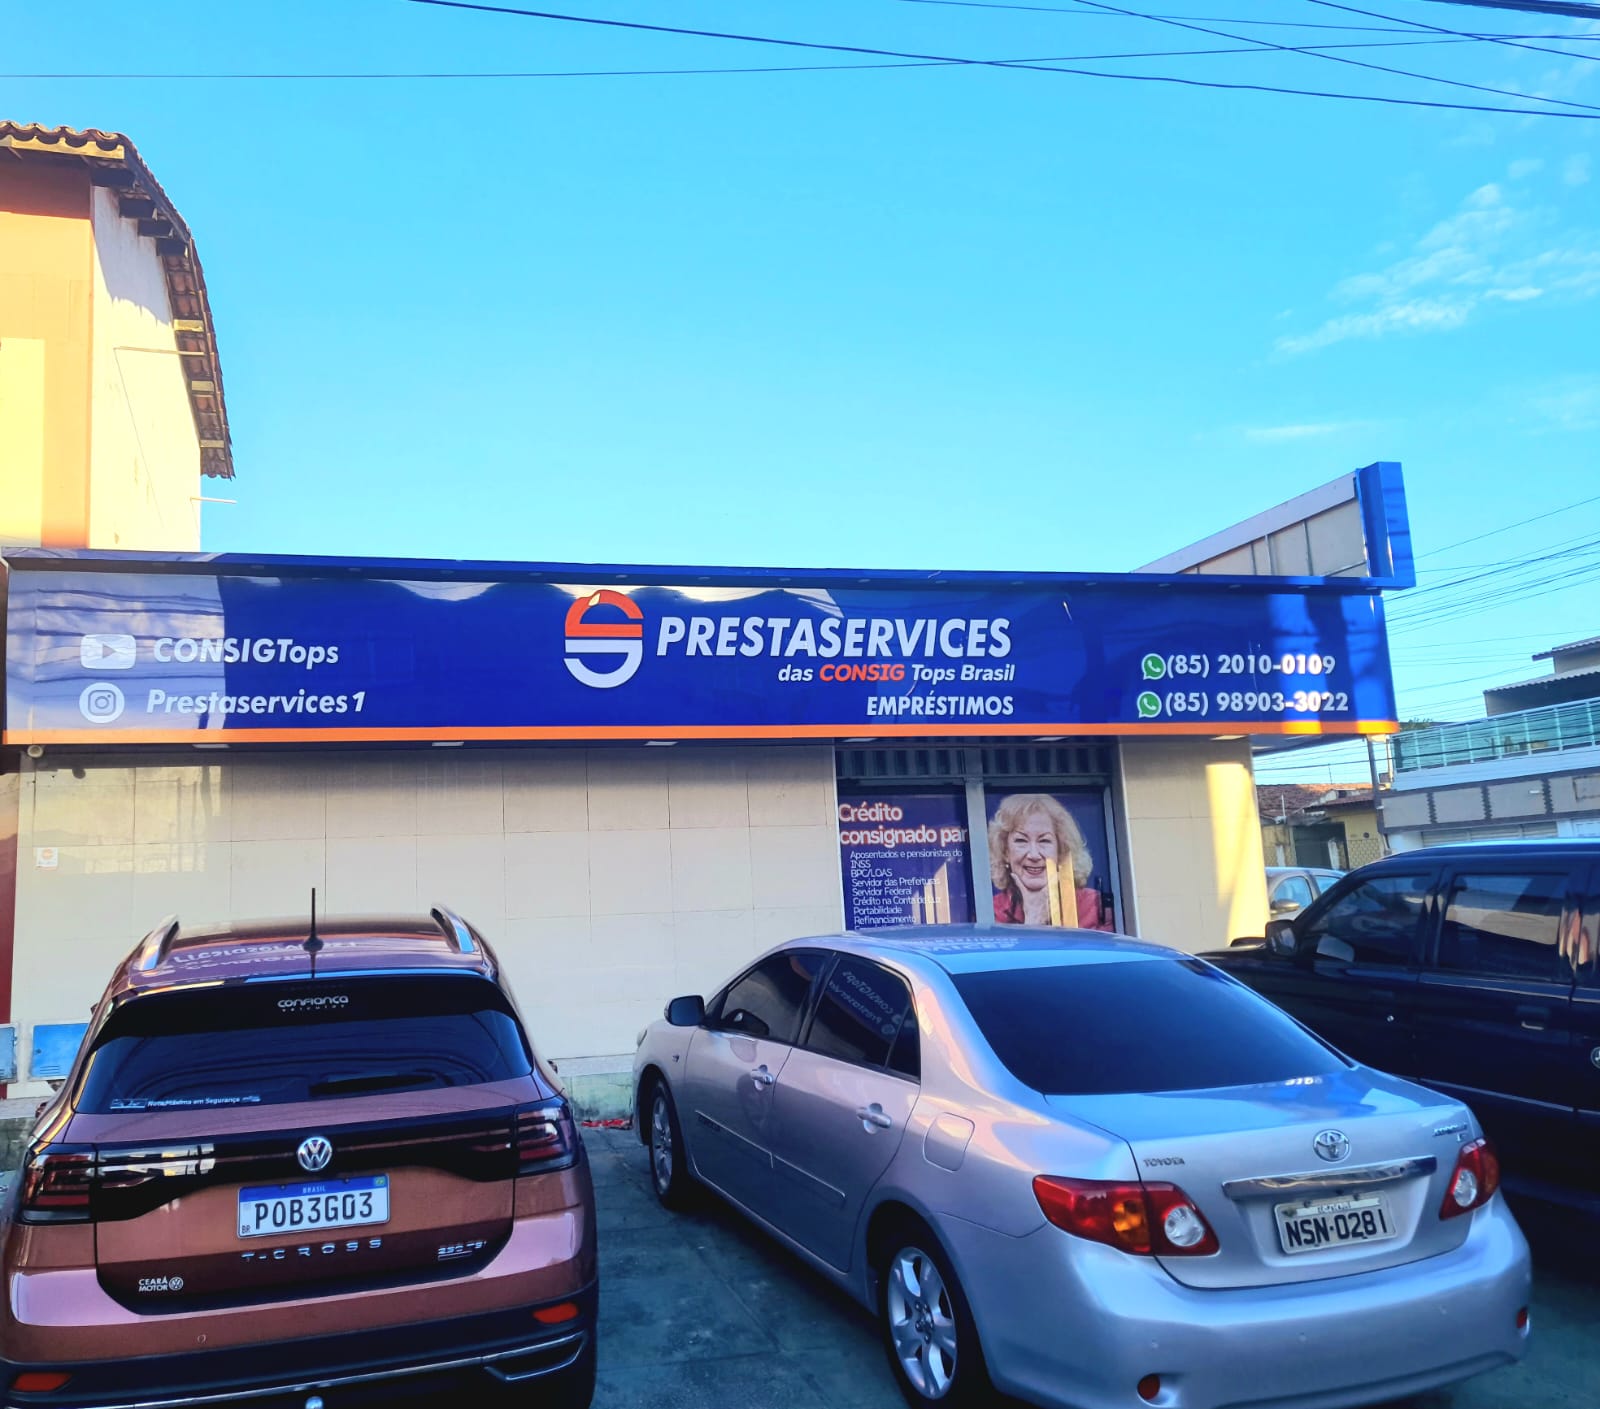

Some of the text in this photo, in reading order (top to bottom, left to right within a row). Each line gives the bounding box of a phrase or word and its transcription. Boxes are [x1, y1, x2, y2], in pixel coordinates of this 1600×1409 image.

[656, 616, 1011, 658] PRESTASERVICES
[153, 638, 339, 669] CONSIGTops
[778, 664, 1015, 685] das CONSIG Tops Brasil
[1167, 654, 1336, 679] (85) 2010-0109
[146, 689, 365, 714] Prestaservices1
[866, 690, 1014, 716] EMPRÉSTIMOS
[1165, 692, 1349, 717] (85) 98903-3022
[838, 801, 903, 822] Crédito
[840, 824, 937, 848] consignado
[850, 850, 899, 860] Aposentados
[906, 849, 951, 859] pensionistas
[953, 849, 963, 857] do
[850, 860, 872, 869] INSS
[850, 868, 893, 878] BPC/LOAS
[852, 879, 883, 888] Servidor
[885, 878, 898, 887] das
[852, 886, 912, 896] Servidor Federal
[882, 897, 892, 905] na
[853, 905, 903, 915] Portabilidade
[302, 1185, 326, 1194] BRASIL
[254, 1191, 373, 1230] POB3G03
[241, 1238, 382, 1262] T-CROSS
